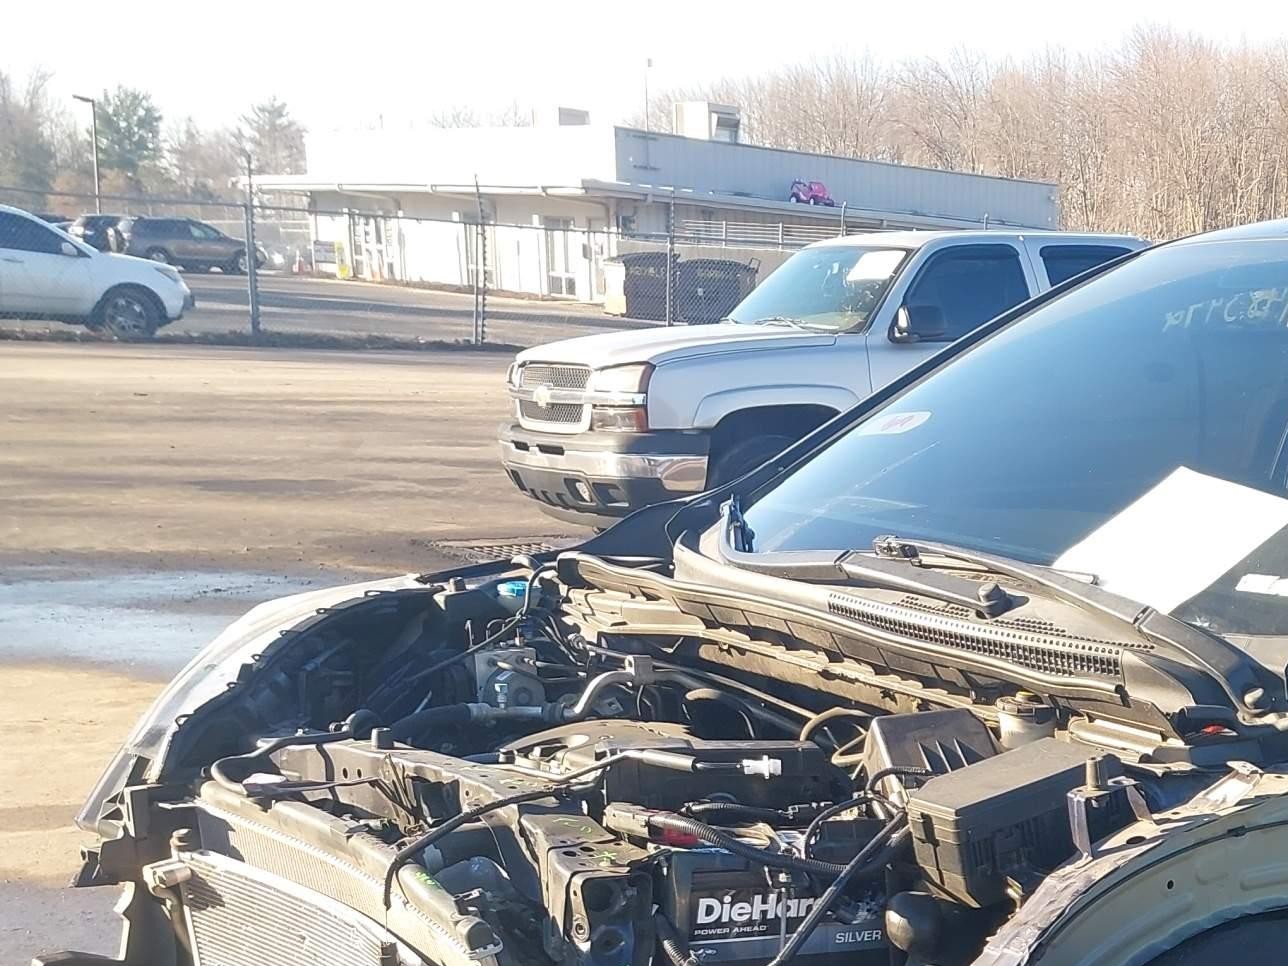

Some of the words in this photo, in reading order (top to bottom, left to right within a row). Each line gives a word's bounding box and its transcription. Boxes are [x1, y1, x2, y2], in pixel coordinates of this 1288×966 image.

[696, 893, 818, 925] DieHar
[694, 927, 730, 936] POWER
[732, 924, 767, 933] AHEAD
[835, 929, 881, 943] SILVER
